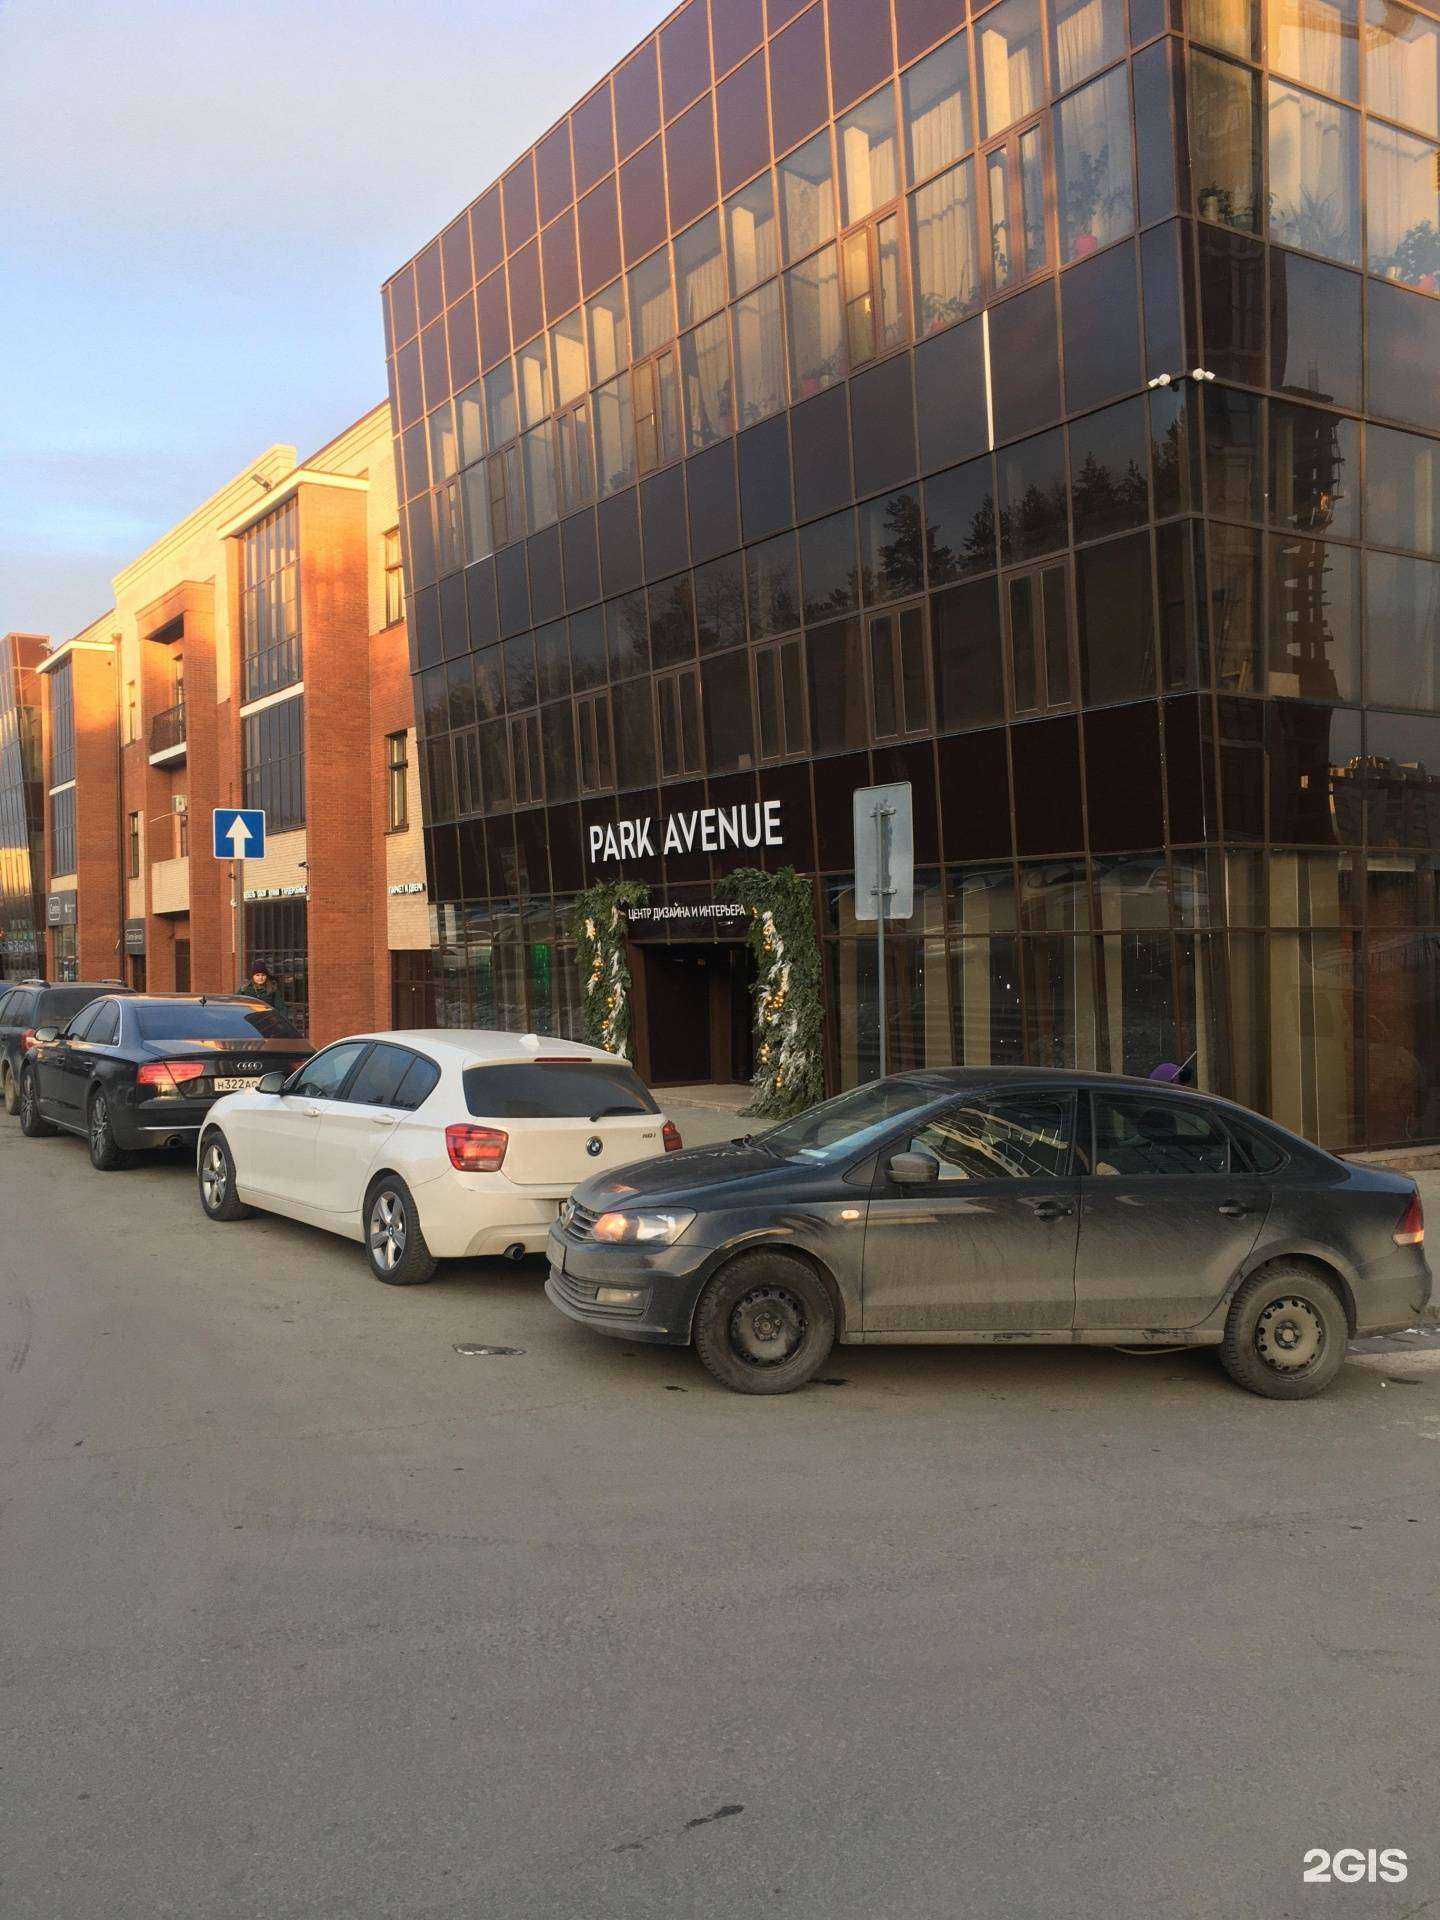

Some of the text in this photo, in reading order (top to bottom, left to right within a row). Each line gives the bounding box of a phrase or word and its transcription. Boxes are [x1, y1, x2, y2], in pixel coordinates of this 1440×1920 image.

[589, 800, 783, 863] PARK AVENUE
[628, 902, 746, 921] ЦЕНТР ДИЗАЙНА И ИНТЕРЬЕРА
